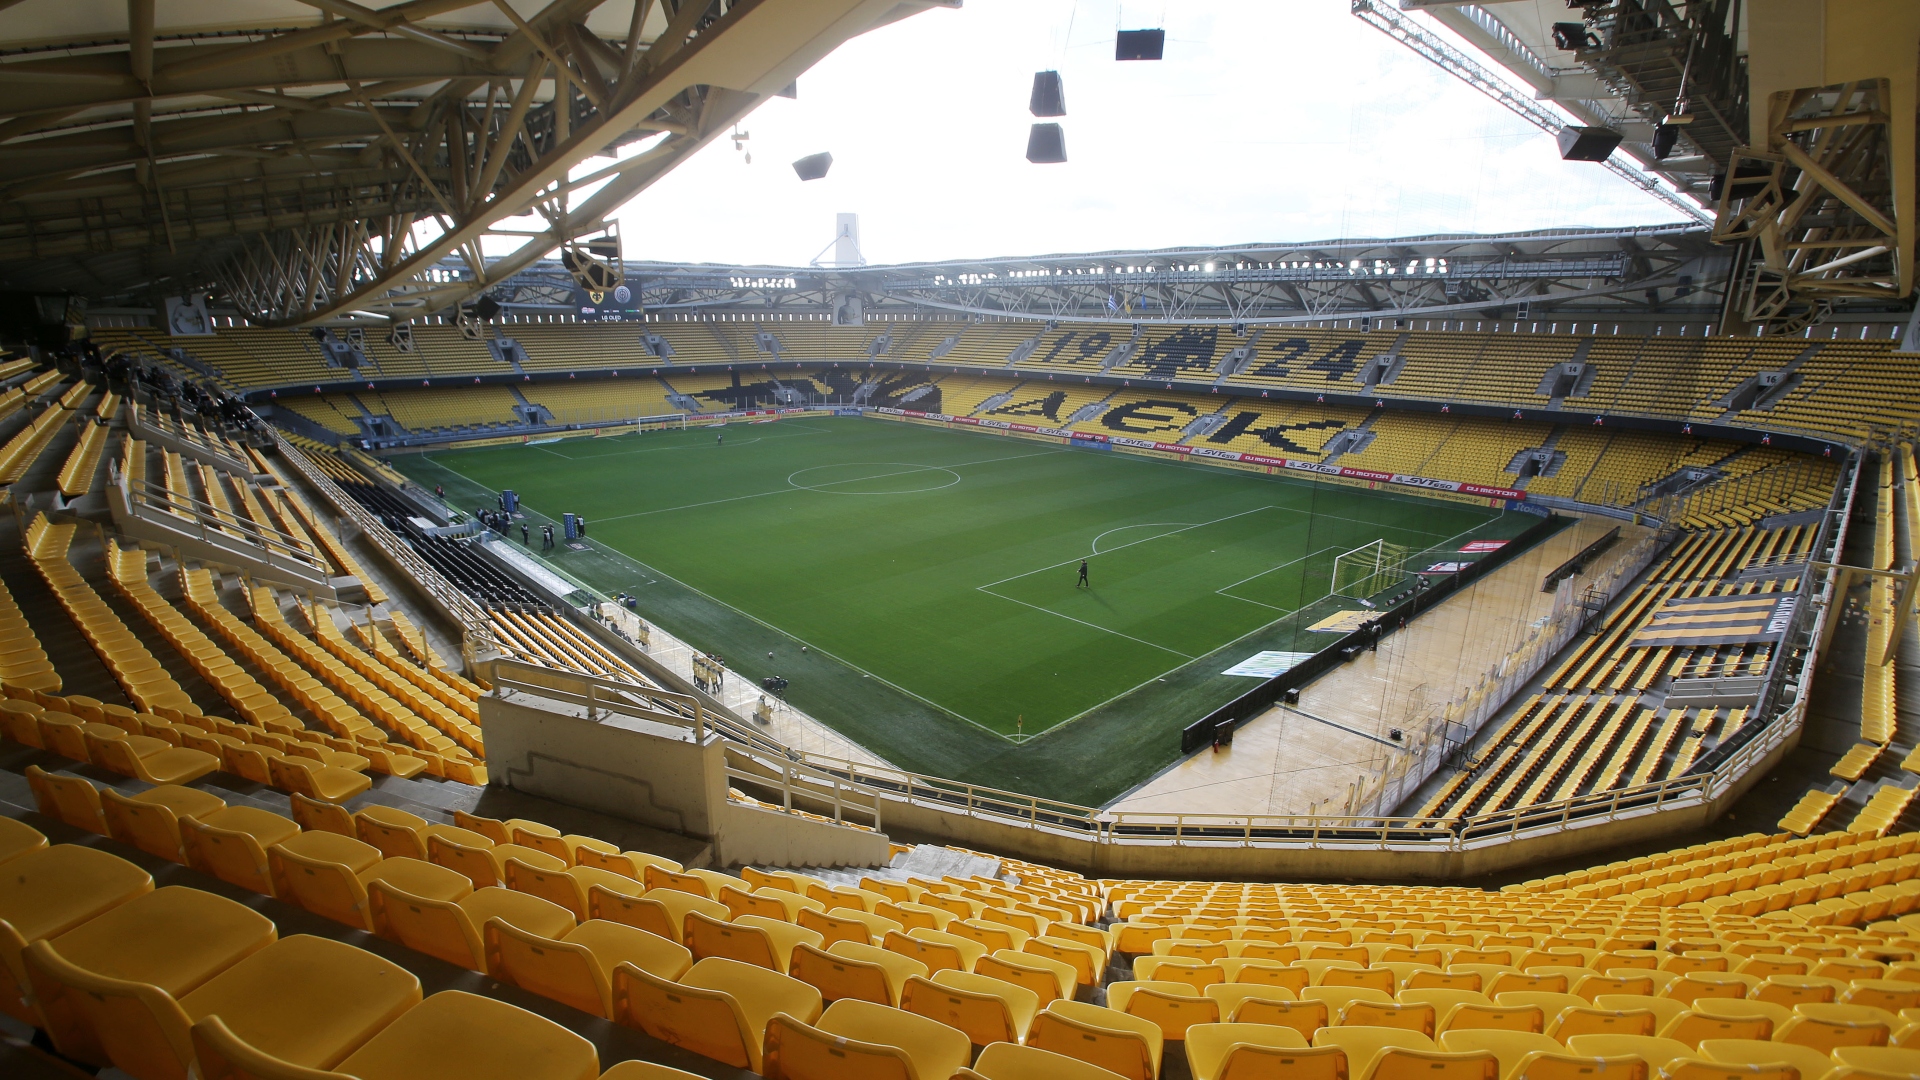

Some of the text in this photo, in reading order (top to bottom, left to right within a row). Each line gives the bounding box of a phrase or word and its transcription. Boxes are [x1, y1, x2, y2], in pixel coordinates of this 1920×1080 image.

[1042, 331, 1111, 363] 19
[1253, 338, 1366, 381] 24
[1765, 375, 1777, 384] 16
[1201, 449, 1236, 460] SVT650
[1297, 462, 1337, 474] SVT650
[1356, 471, 1389, 480] MOTOR
[1404, 477, 1452, 490] SVT650
[1480, 487, 1517, 497] MOTOR
